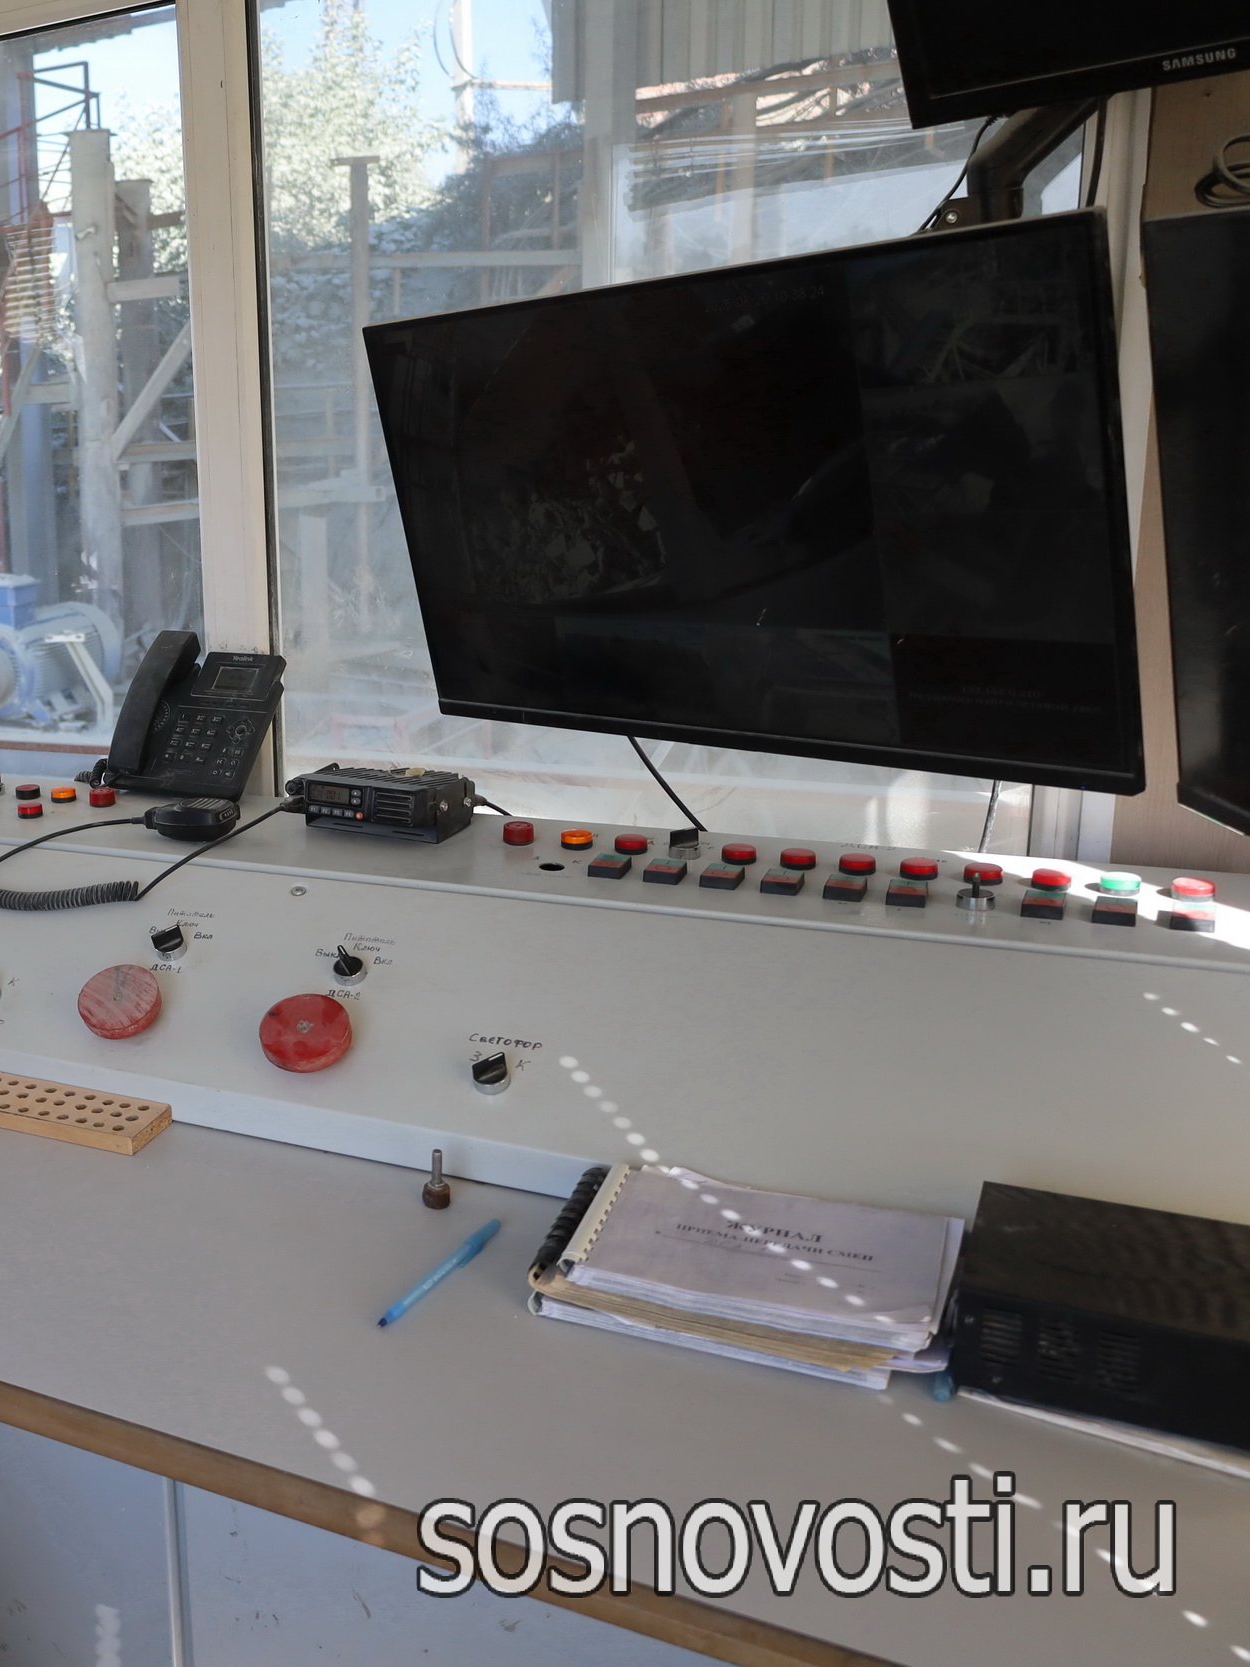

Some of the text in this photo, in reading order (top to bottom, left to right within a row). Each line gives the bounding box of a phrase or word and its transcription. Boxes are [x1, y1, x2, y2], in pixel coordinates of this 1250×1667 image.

[1162, 48, 1236, 71] SAMSUNG
[194, 932, 213, 940] Вкл
[353, 943, 381, 952] Ключ
[374, 956, 392, 965] Вкл
[149, 963, 181, 974] ДСА-1
[325, 989, 361, 1000] ДСА-2
[726, 1220, 823, 1243] ЖУРНАЛ
[828, 1249, 874, 1262] СМЕН
